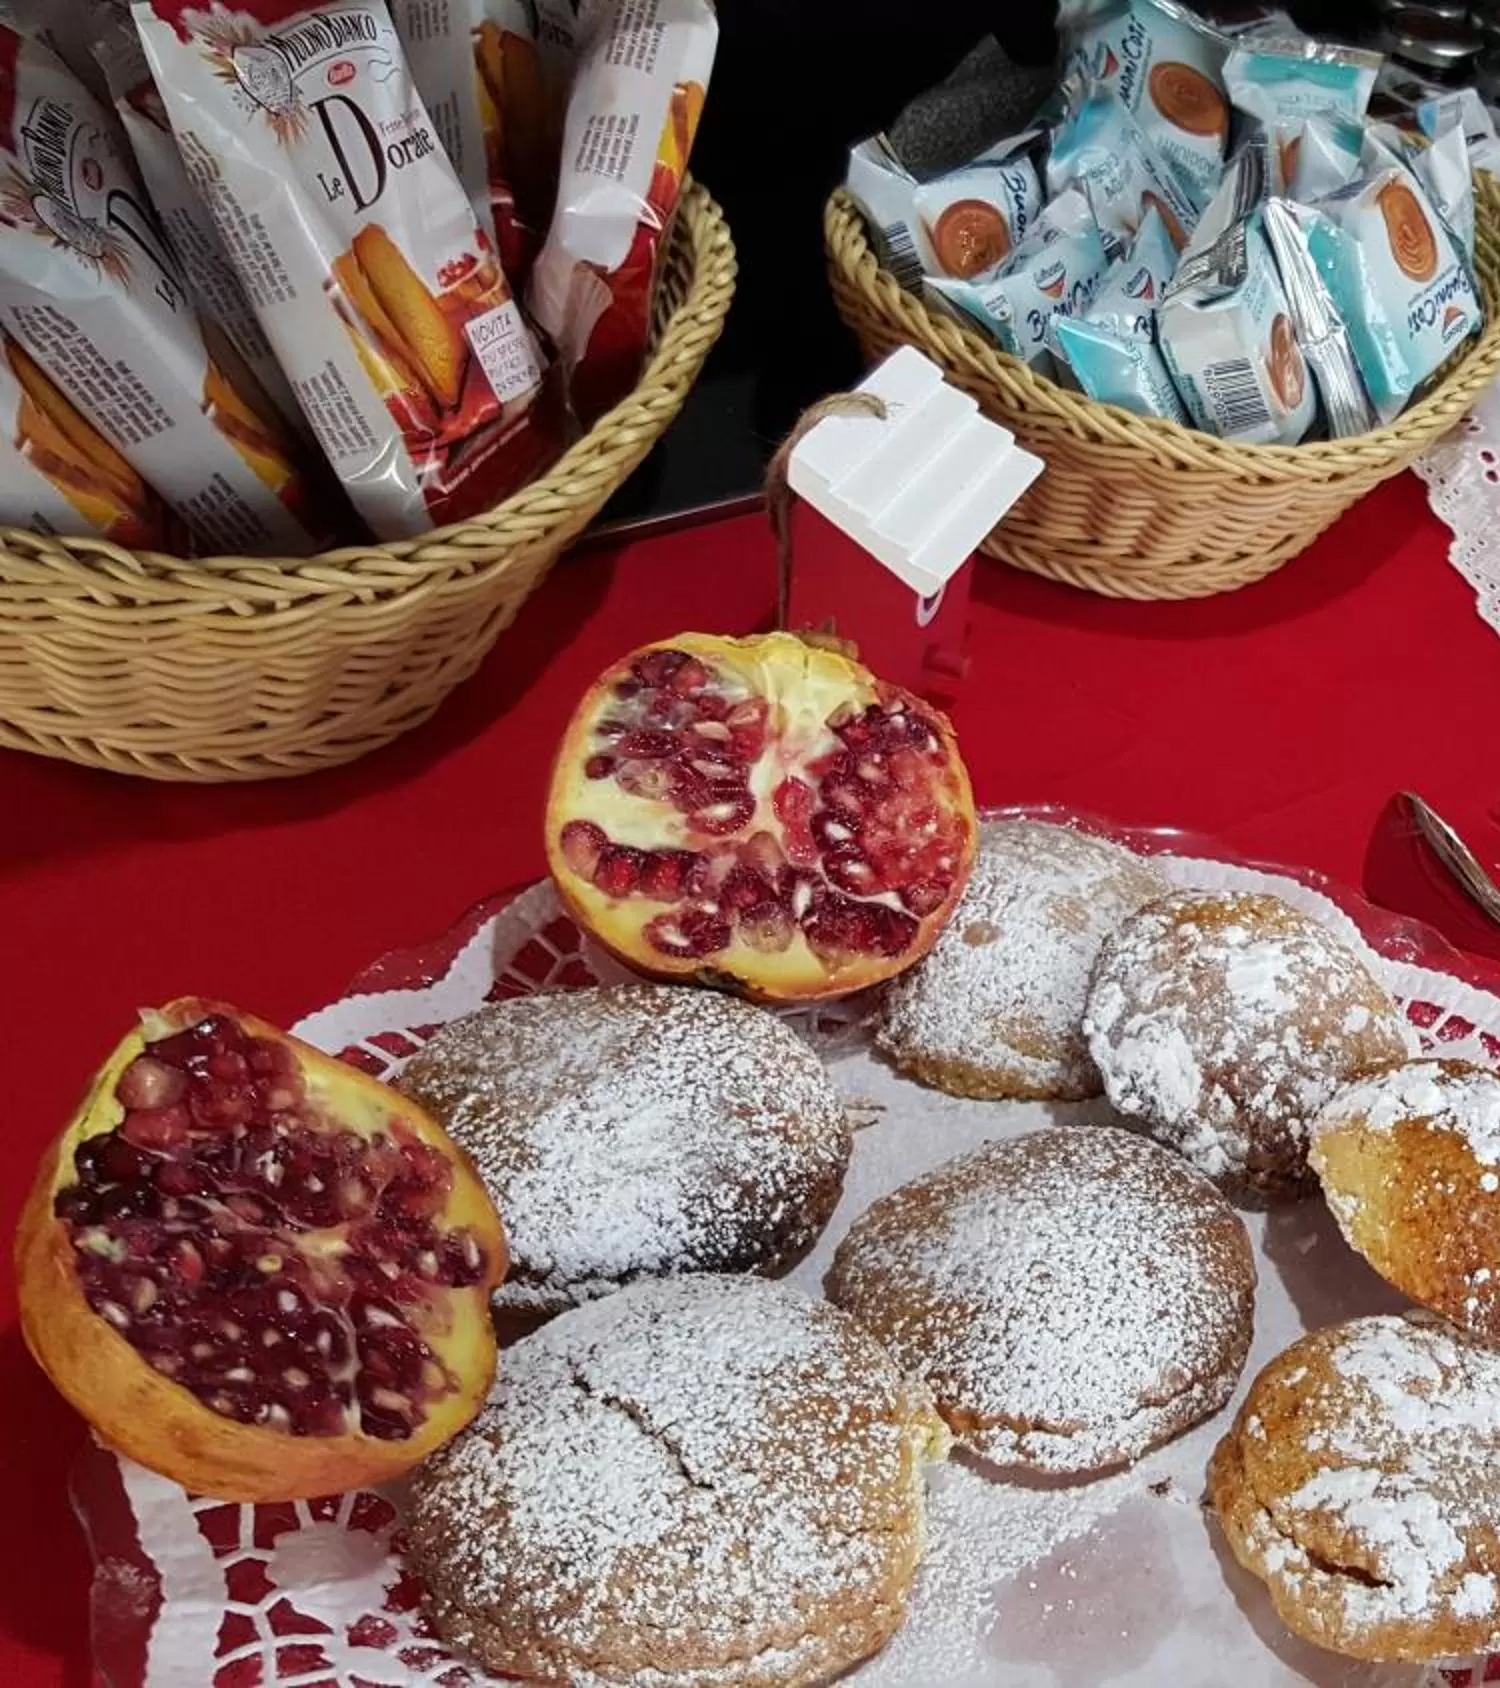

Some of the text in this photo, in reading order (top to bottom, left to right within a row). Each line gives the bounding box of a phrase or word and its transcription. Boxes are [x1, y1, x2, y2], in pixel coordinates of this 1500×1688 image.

[262, 22, 332, 73] MULINO
[312, 13, 377, 48] BIANCO
[317, 172, 345, 202] Le
